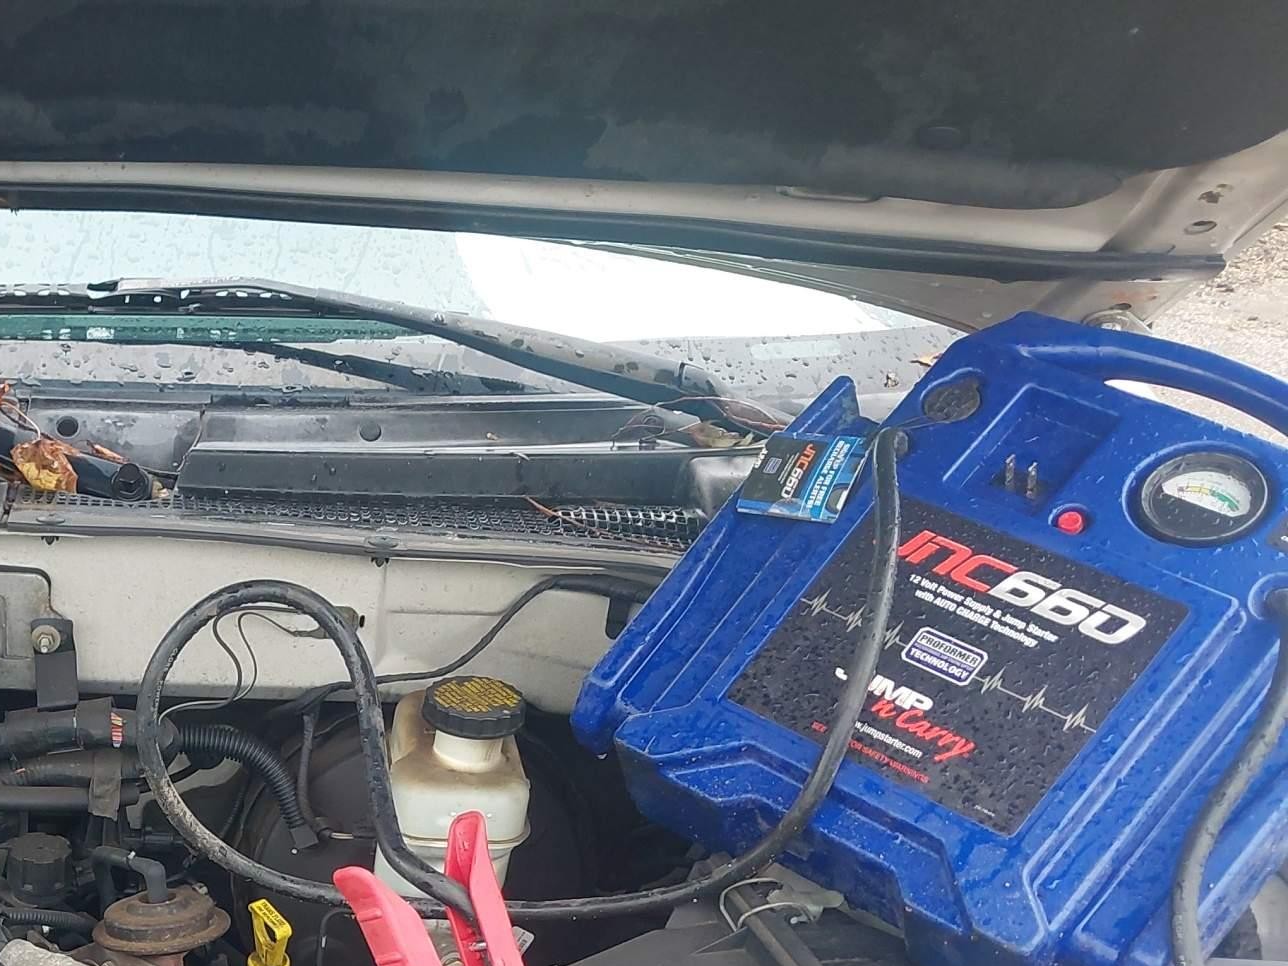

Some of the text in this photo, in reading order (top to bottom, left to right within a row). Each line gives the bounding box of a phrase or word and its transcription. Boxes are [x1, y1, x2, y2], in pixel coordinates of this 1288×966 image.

[910, 573, 921, 585] 12
[920, 576, 939, 592] Volt
[937, 582, 964, 602] Power
[963, 594, 994, 618] Supply
[1000, 612, 1028, 633] Jump
[1026, 622, 1059, 643] Starter
[914, 589, 1039, 649] with AUTO CHARGE Technology
[910, 649, 970, 680] TECHNOLOGY
[919, 633, 982, 667] PROFORMER
[896, 709, 976, 764] Carry
